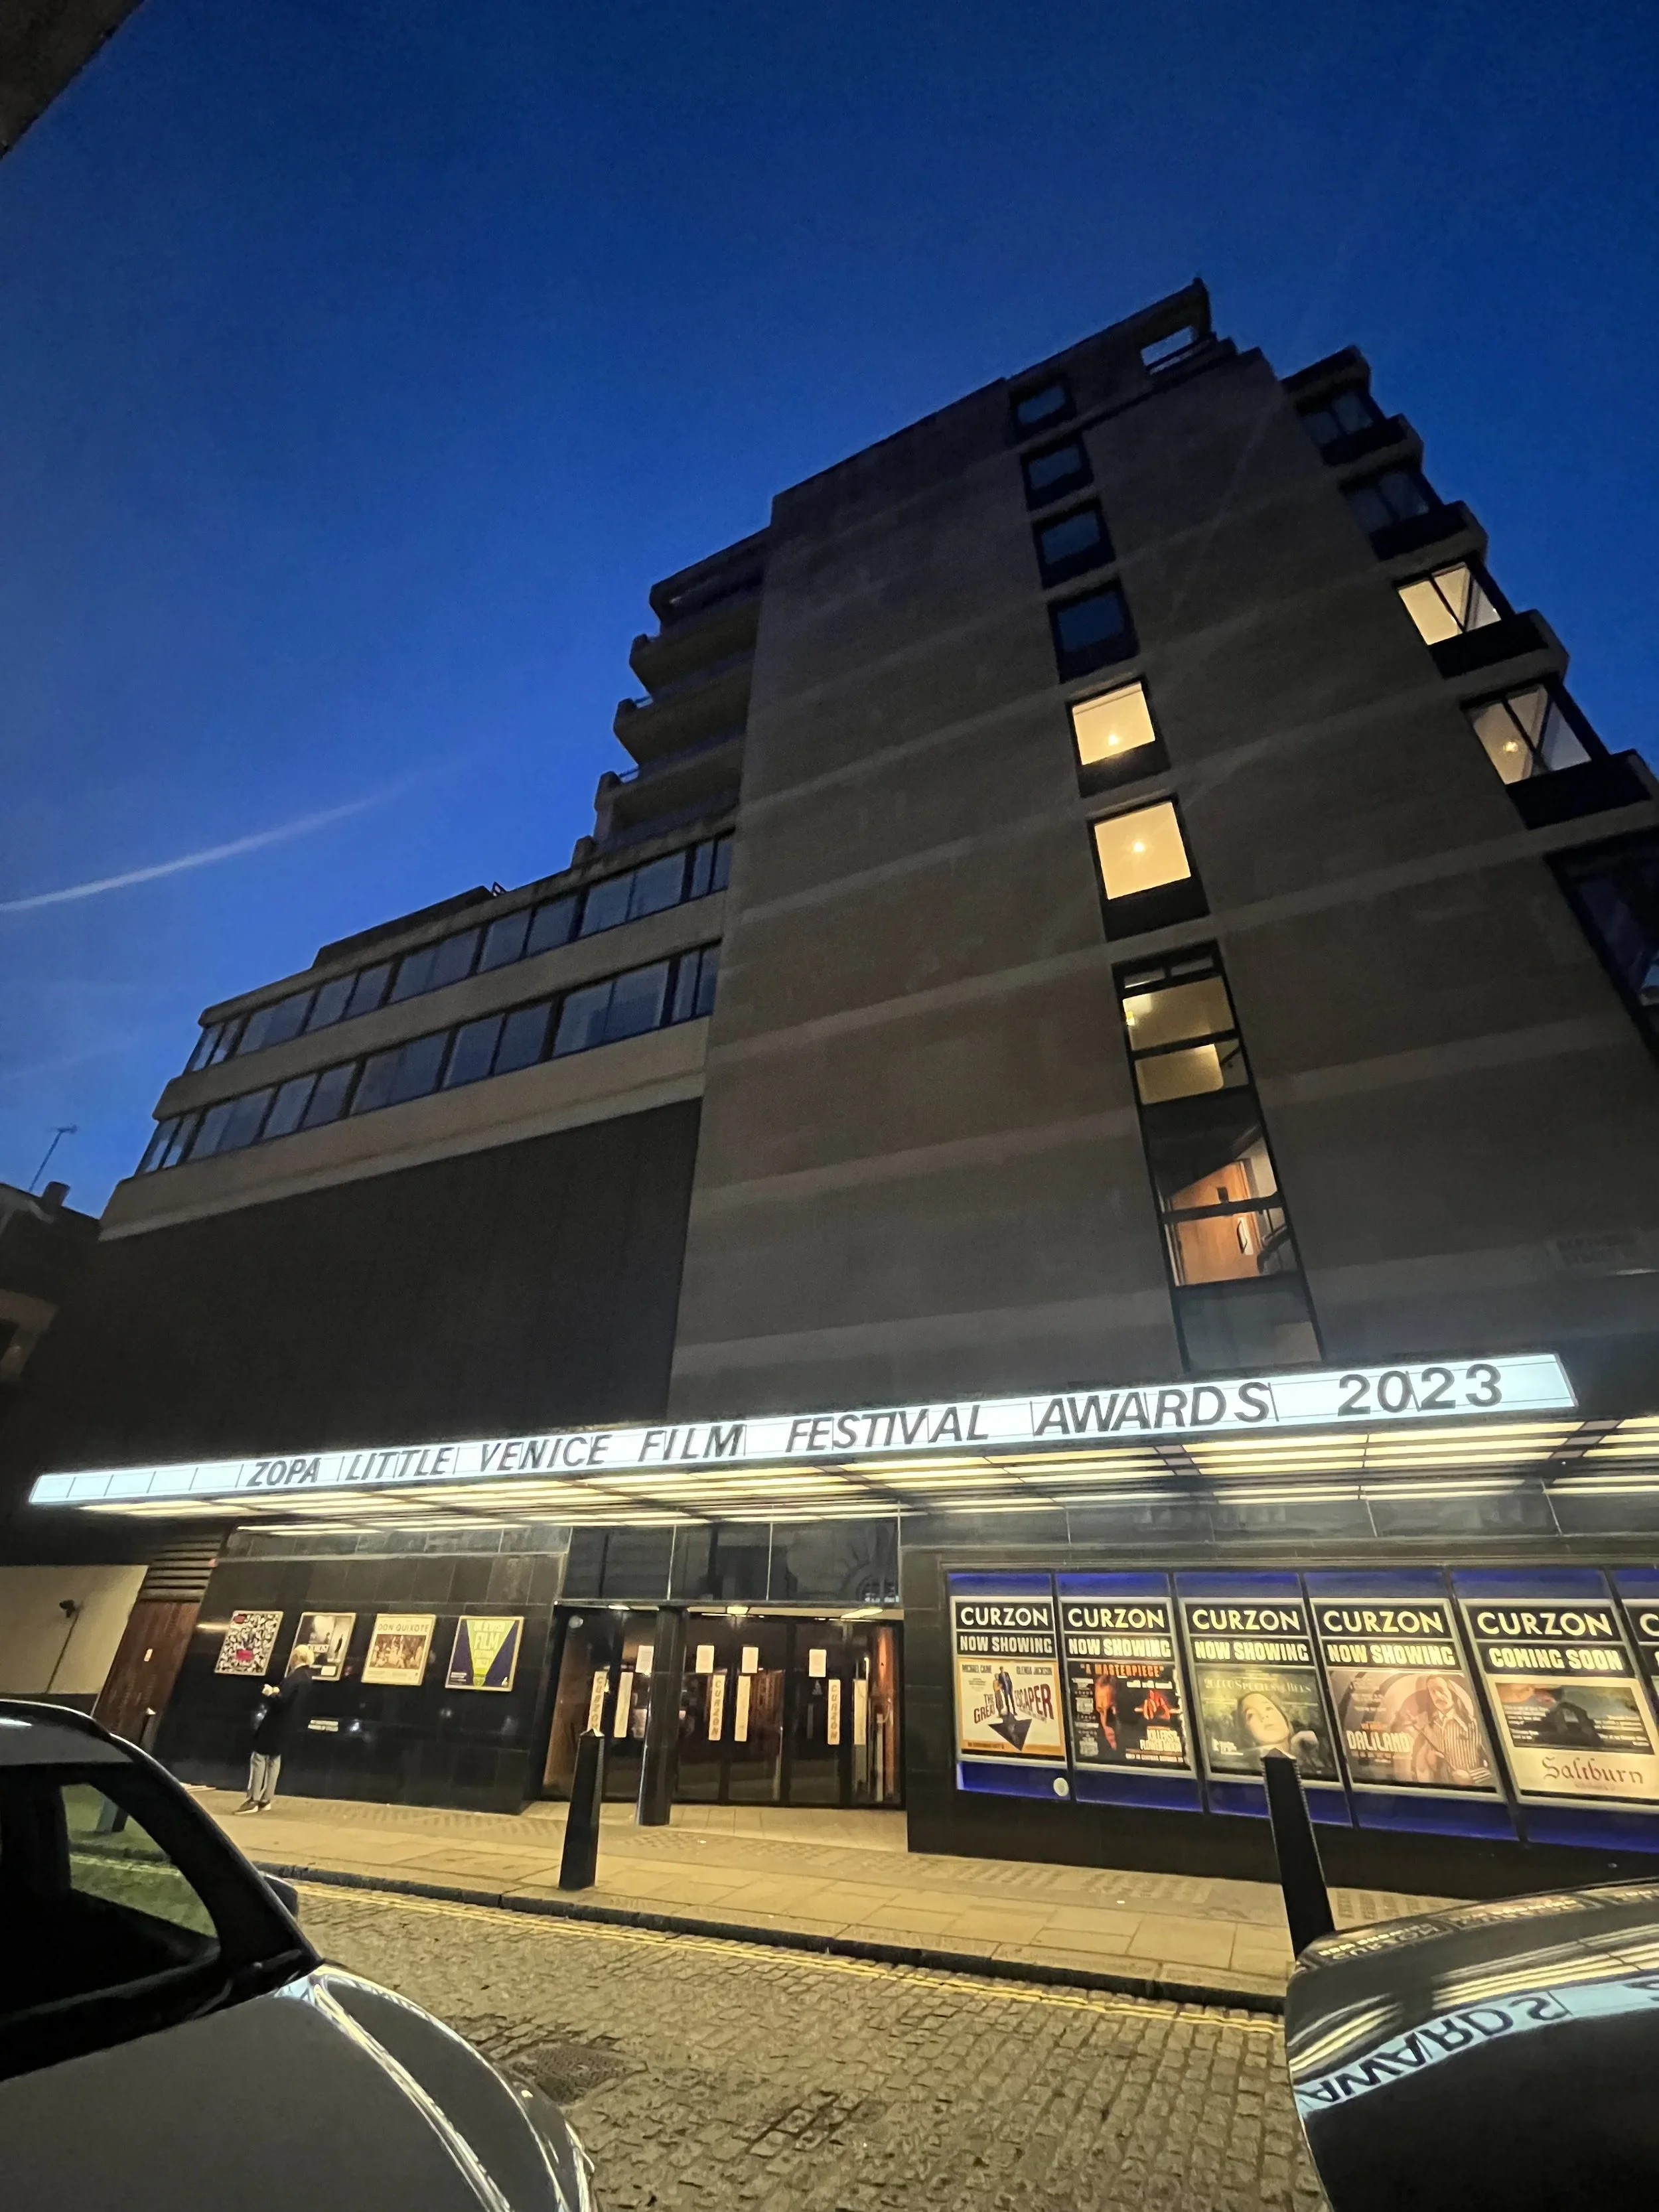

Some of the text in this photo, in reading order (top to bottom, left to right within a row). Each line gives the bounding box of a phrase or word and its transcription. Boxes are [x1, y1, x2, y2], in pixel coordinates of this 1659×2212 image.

[246, 1364, 1502, 1487] ZOPA LITTLE VENICE FILM FESTIVAL AWARDS 2023
[961, 1607, 1048, 1626] CURZON
[1068, 1608, 1165, 1628] CURZON
[1192, 1609, 1300, 1631] CURZON
[1324, 1611, 1444, 1633] CURZON
[1477, 1612, 1613, 1636] CURZON
[396, 1623, 429, 1632] QUIXOTE
[474, 1631, 500, 1649] FILM
[960, 1636, 1052, 1654] NOW SHOWING
[1068, 1638, 1171, 1657] NOW SHOWING
[1194, 1641, 1309, 1661] NOW SHOWING
[1328, 1644, 1455, 1665] NOW SHOWING
[1488, 1648, 1623, 1670] COMING SOON
[712, 1680, 722, 1735] CURZON
[983, 1694, 994, 1706] THE
[1015, 1684, 1054, 1720] ESCAPER
[974, 1704, 995, 1724] GREAT
